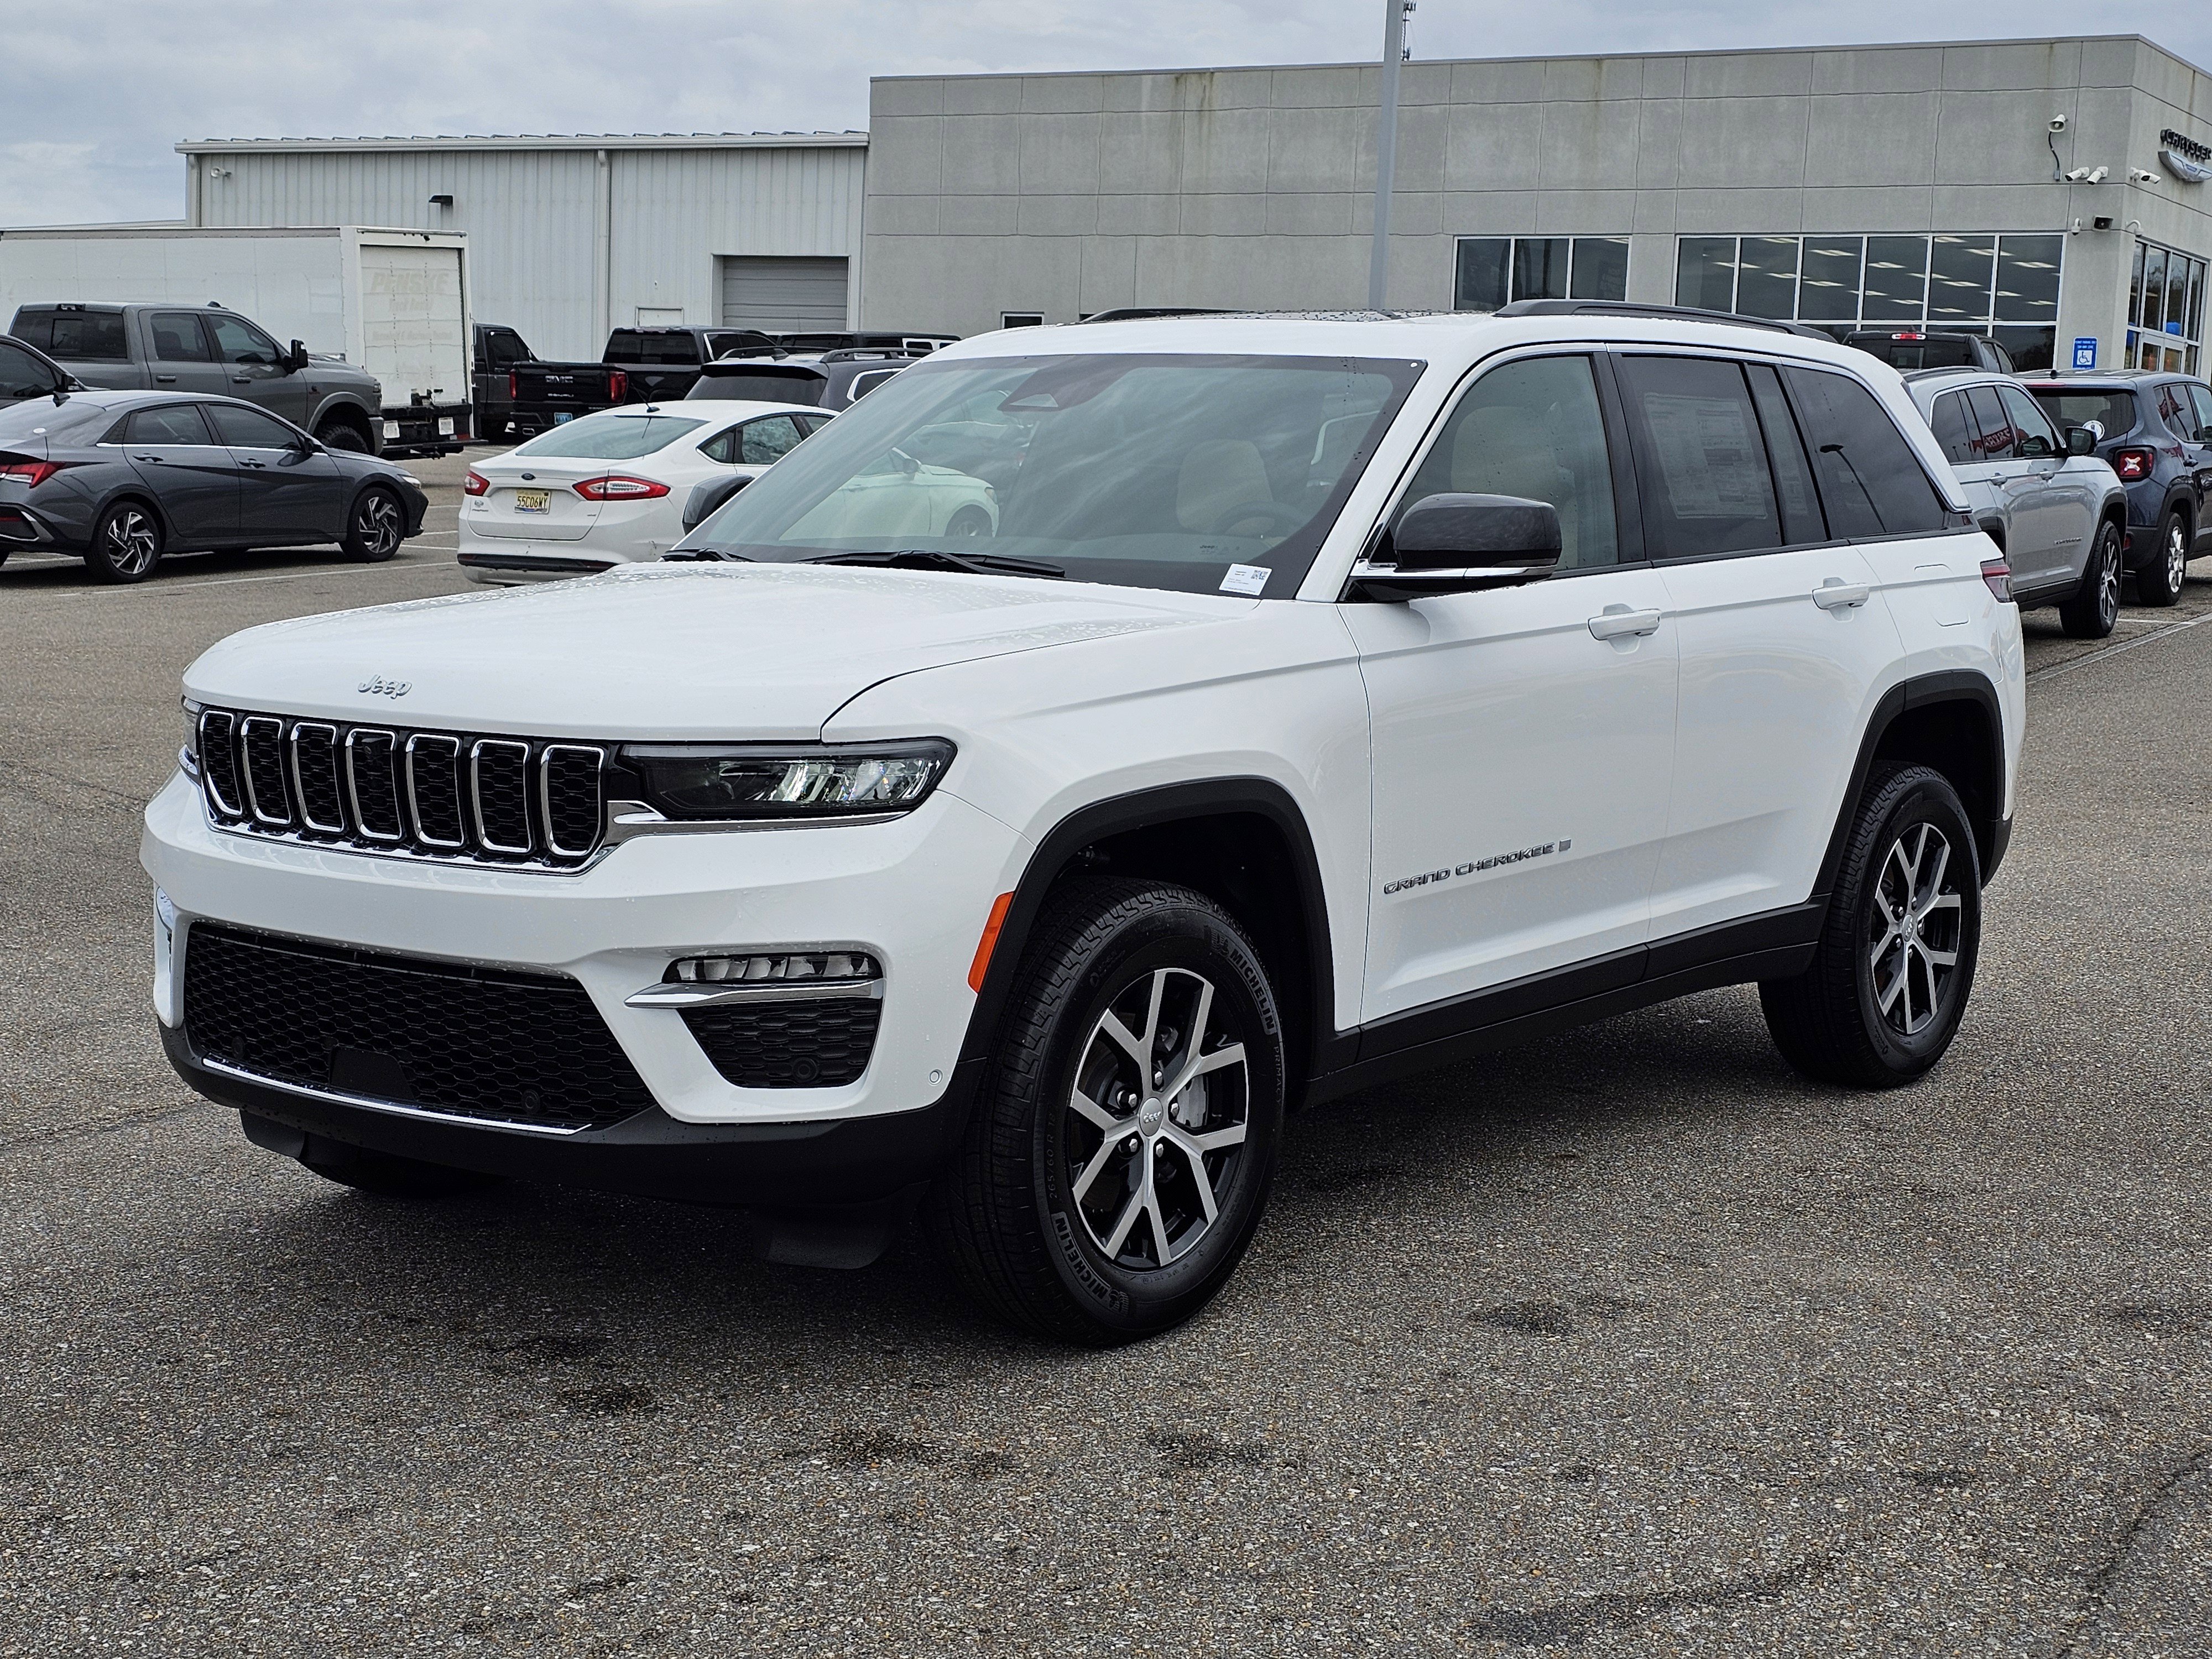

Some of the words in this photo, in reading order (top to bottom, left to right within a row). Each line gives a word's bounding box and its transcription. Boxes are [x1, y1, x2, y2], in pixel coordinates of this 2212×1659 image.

[2160, 129, 2211, 160] CHRYSLER
[371, 273, 449, 292] PENSKE
[358, 674, 412, 700] Jeep
[1384, 868, 1451, 894] GRAND
[1455, 842, 1554, 876] CHEROKEE
[1230, 948, 1275, 1029] MICHELIN
[1046, 1149, 1058, 1199] 265/60
[1056, 1217, 1109, 1300] MICHELIN
